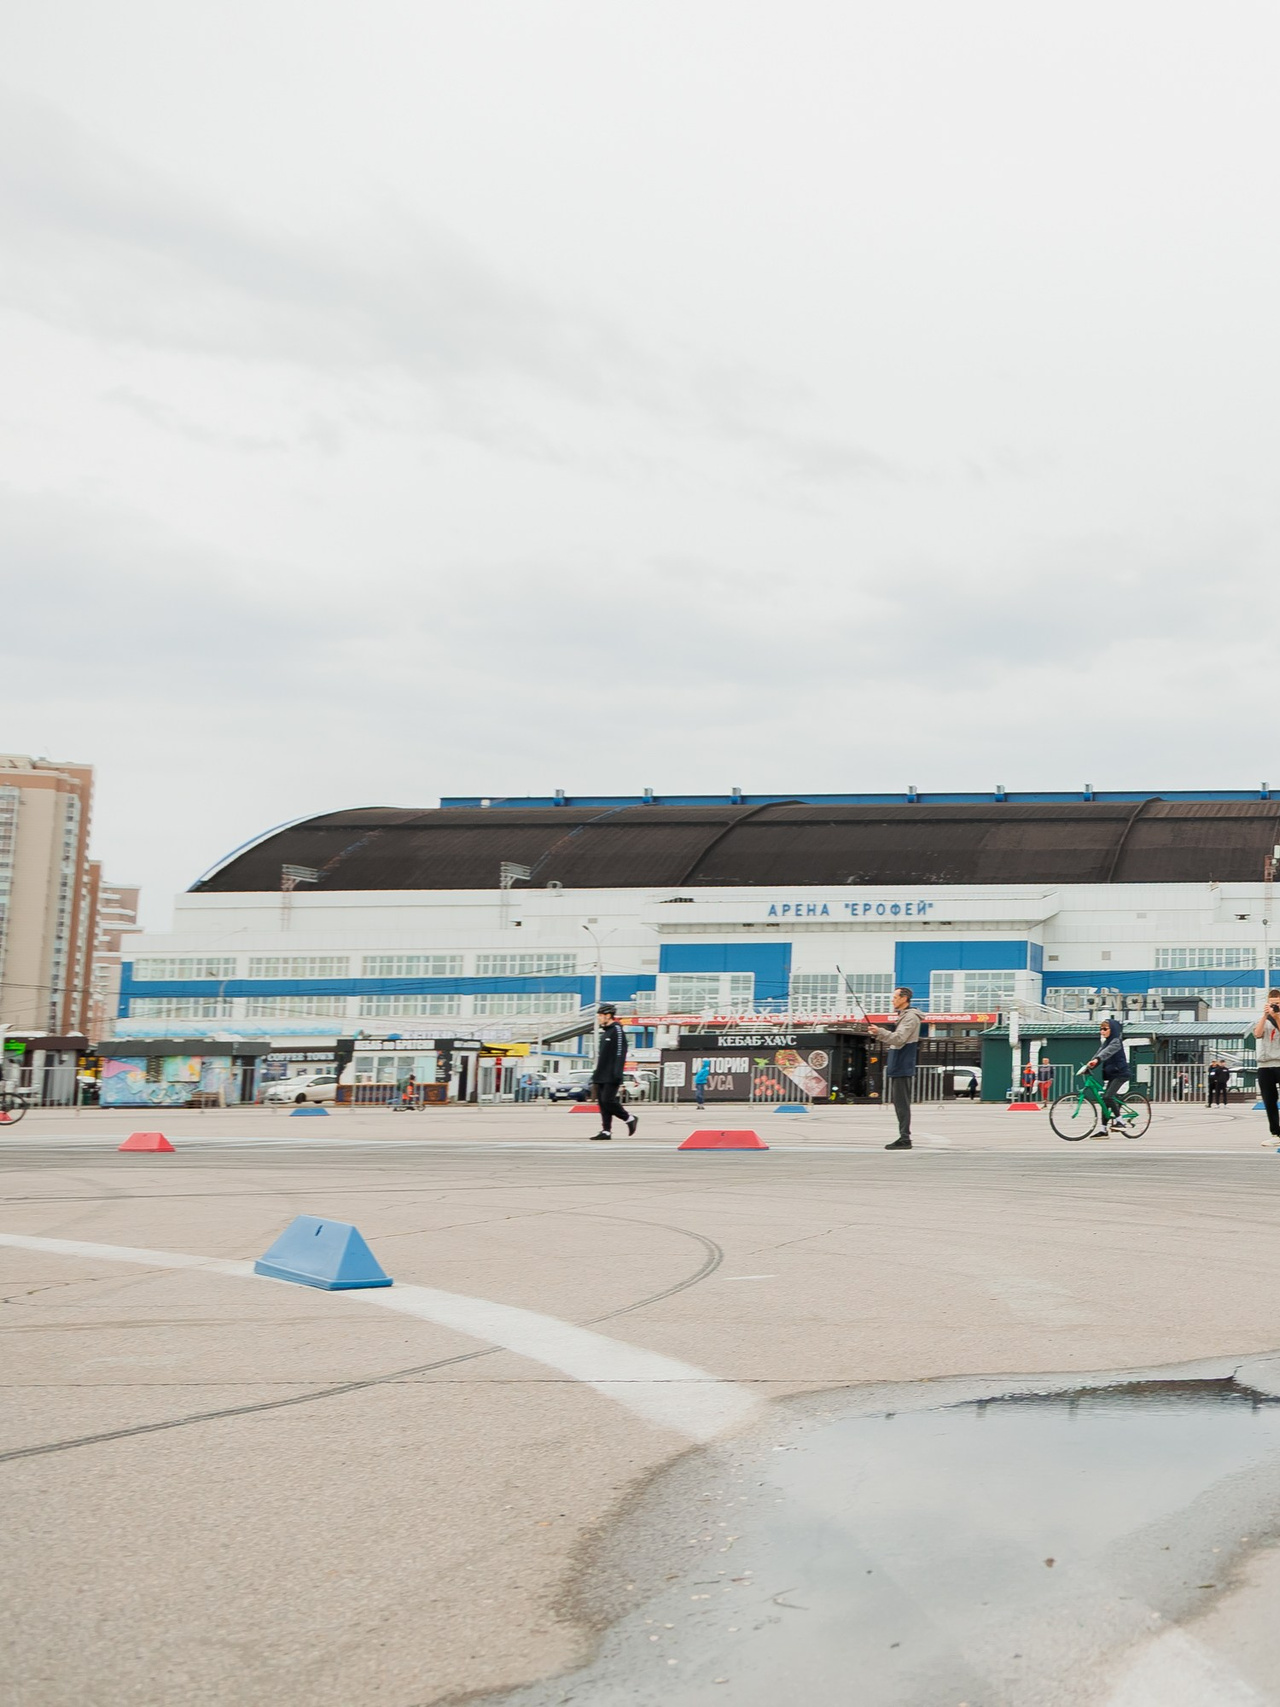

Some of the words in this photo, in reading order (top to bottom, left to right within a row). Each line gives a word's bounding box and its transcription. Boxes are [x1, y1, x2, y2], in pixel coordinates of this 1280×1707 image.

[768, 903, 830, 917] АРЕНА
[844, 900, 934, 916] "ЕРОФЕЙ"
[717, 1035, 797, 1047] КЕБАБ-ХАУС
[267, 1052, 305, 1062] COFFEE
[692, 1057, 749, 1074] ИТОРИЯ
[691, 1075, 734, 1091] УСА
